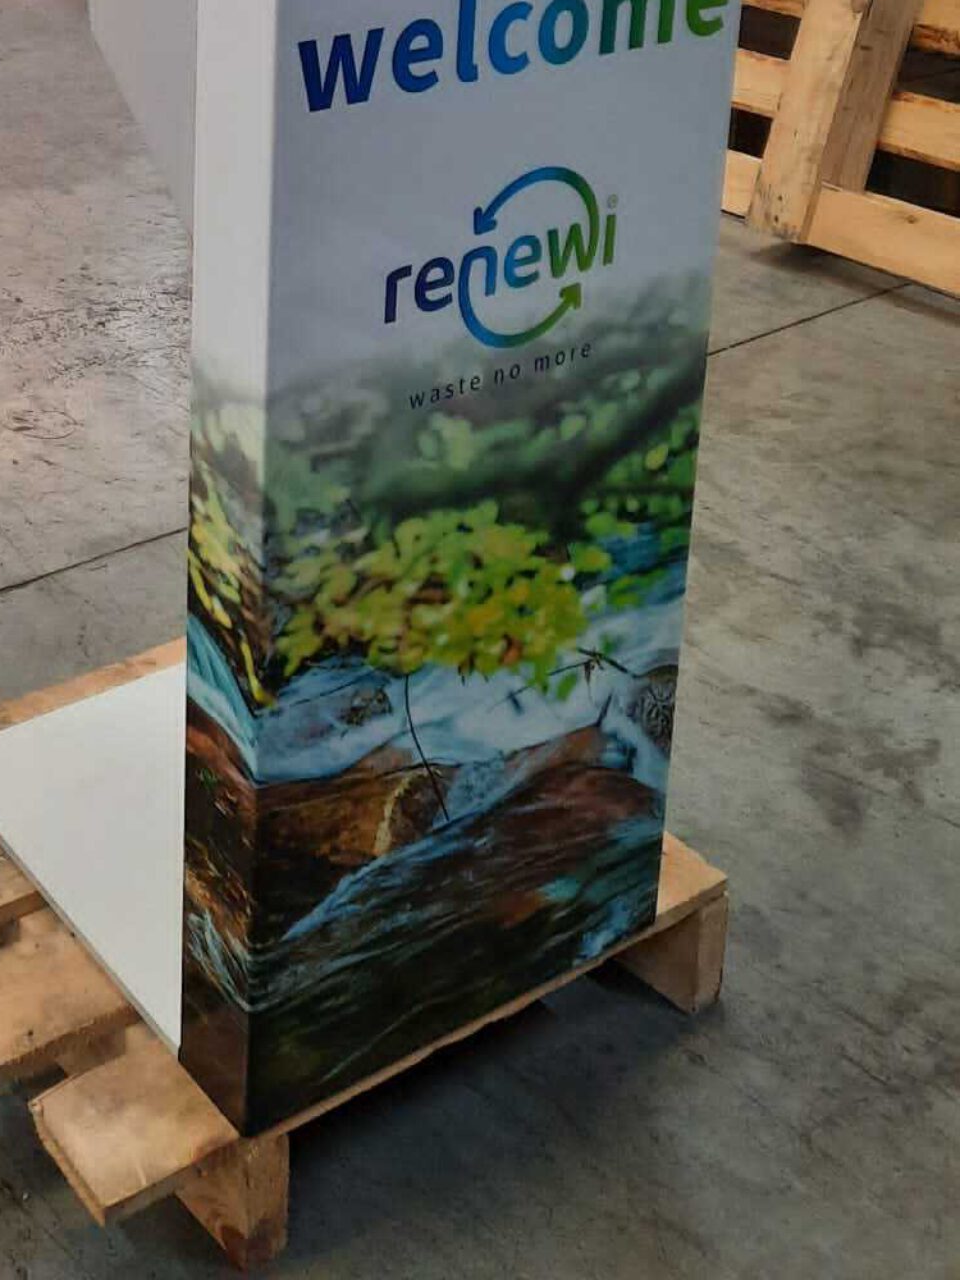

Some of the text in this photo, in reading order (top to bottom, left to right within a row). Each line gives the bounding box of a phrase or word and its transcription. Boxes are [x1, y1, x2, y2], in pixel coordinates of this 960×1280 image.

[383, 208, 618, 326] renewi
[409, 342, 591, 410] waste no more
